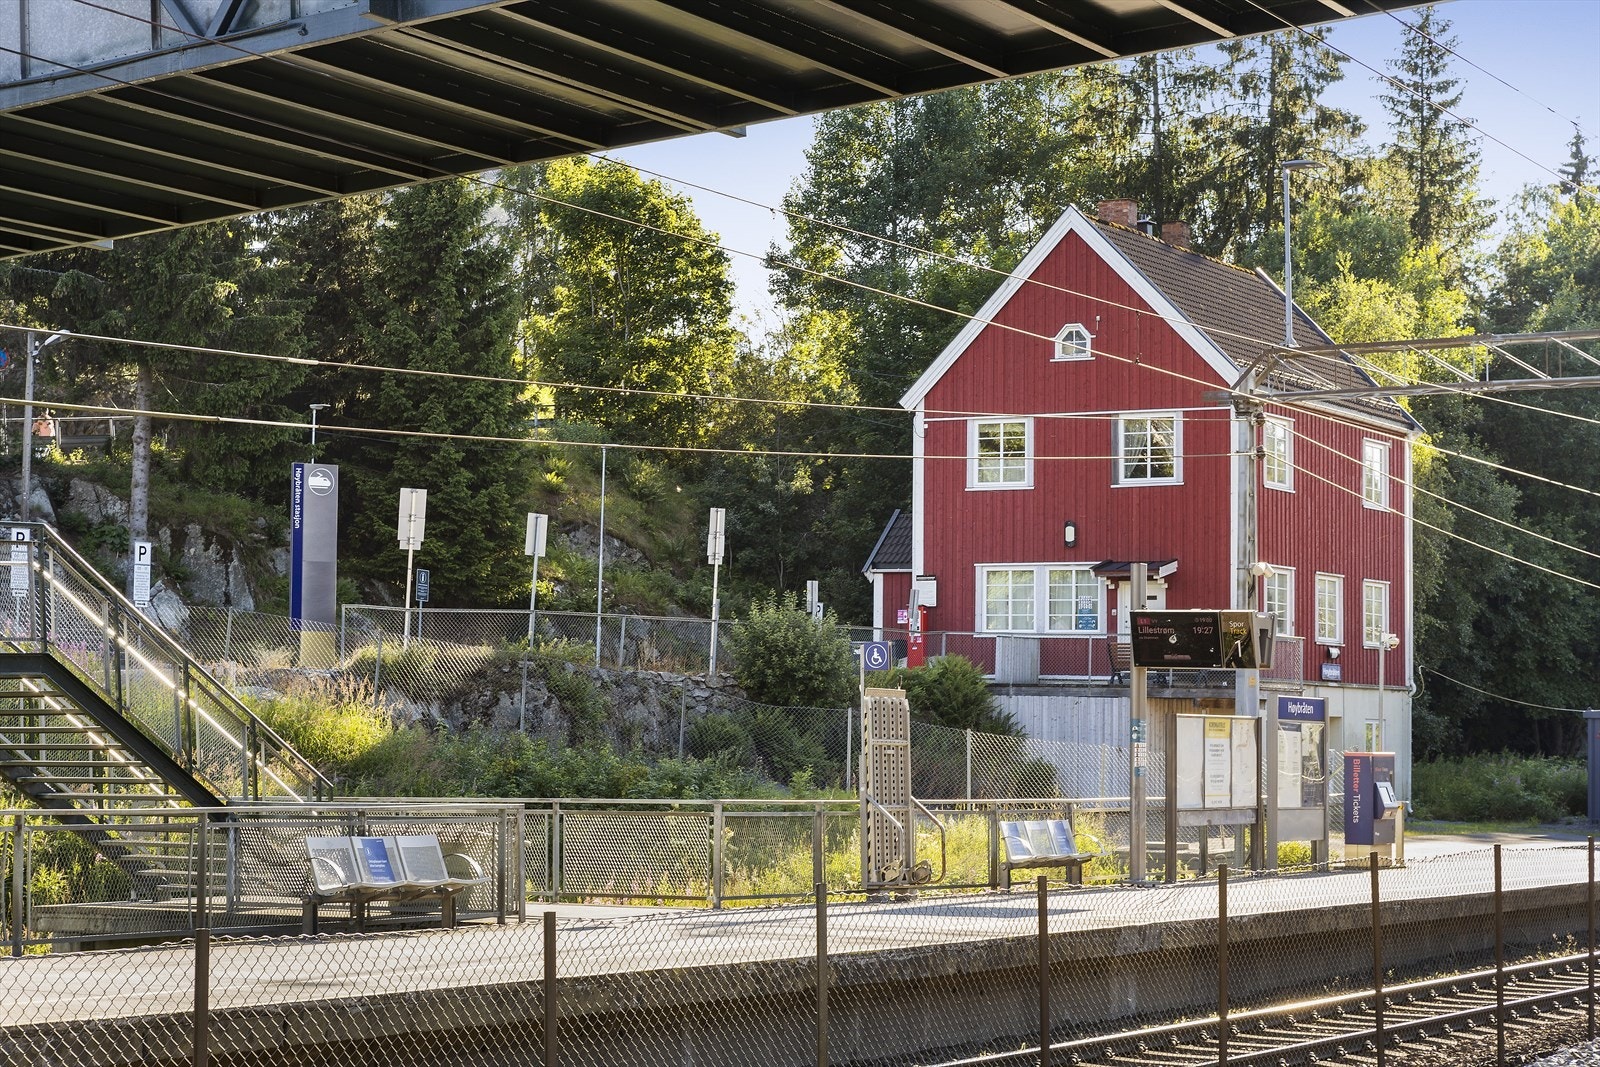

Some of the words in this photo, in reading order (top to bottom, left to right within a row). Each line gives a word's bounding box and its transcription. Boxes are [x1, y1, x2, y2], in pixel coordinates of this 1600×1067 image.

[294, 467, 302, 504] Høybråten
[293, 505, 301, 529] stasjon
[16, 532, 25, 548] P
[138, 545, 147, 561] P
[1138, 626, 1175, 634] Lillestrøm
[1192, 626, 1214, 634] 19:27
[1229, 621, 1244, 629] Spor
[1230, 627, 1247, 635] Track
[1235, 640, 1242, 658] 1
[1287, 701, 1314, 716] Høybråten
[1352, 758, 1361, 793] Billetter
[1352, 794, 1361, 824] Tickets
